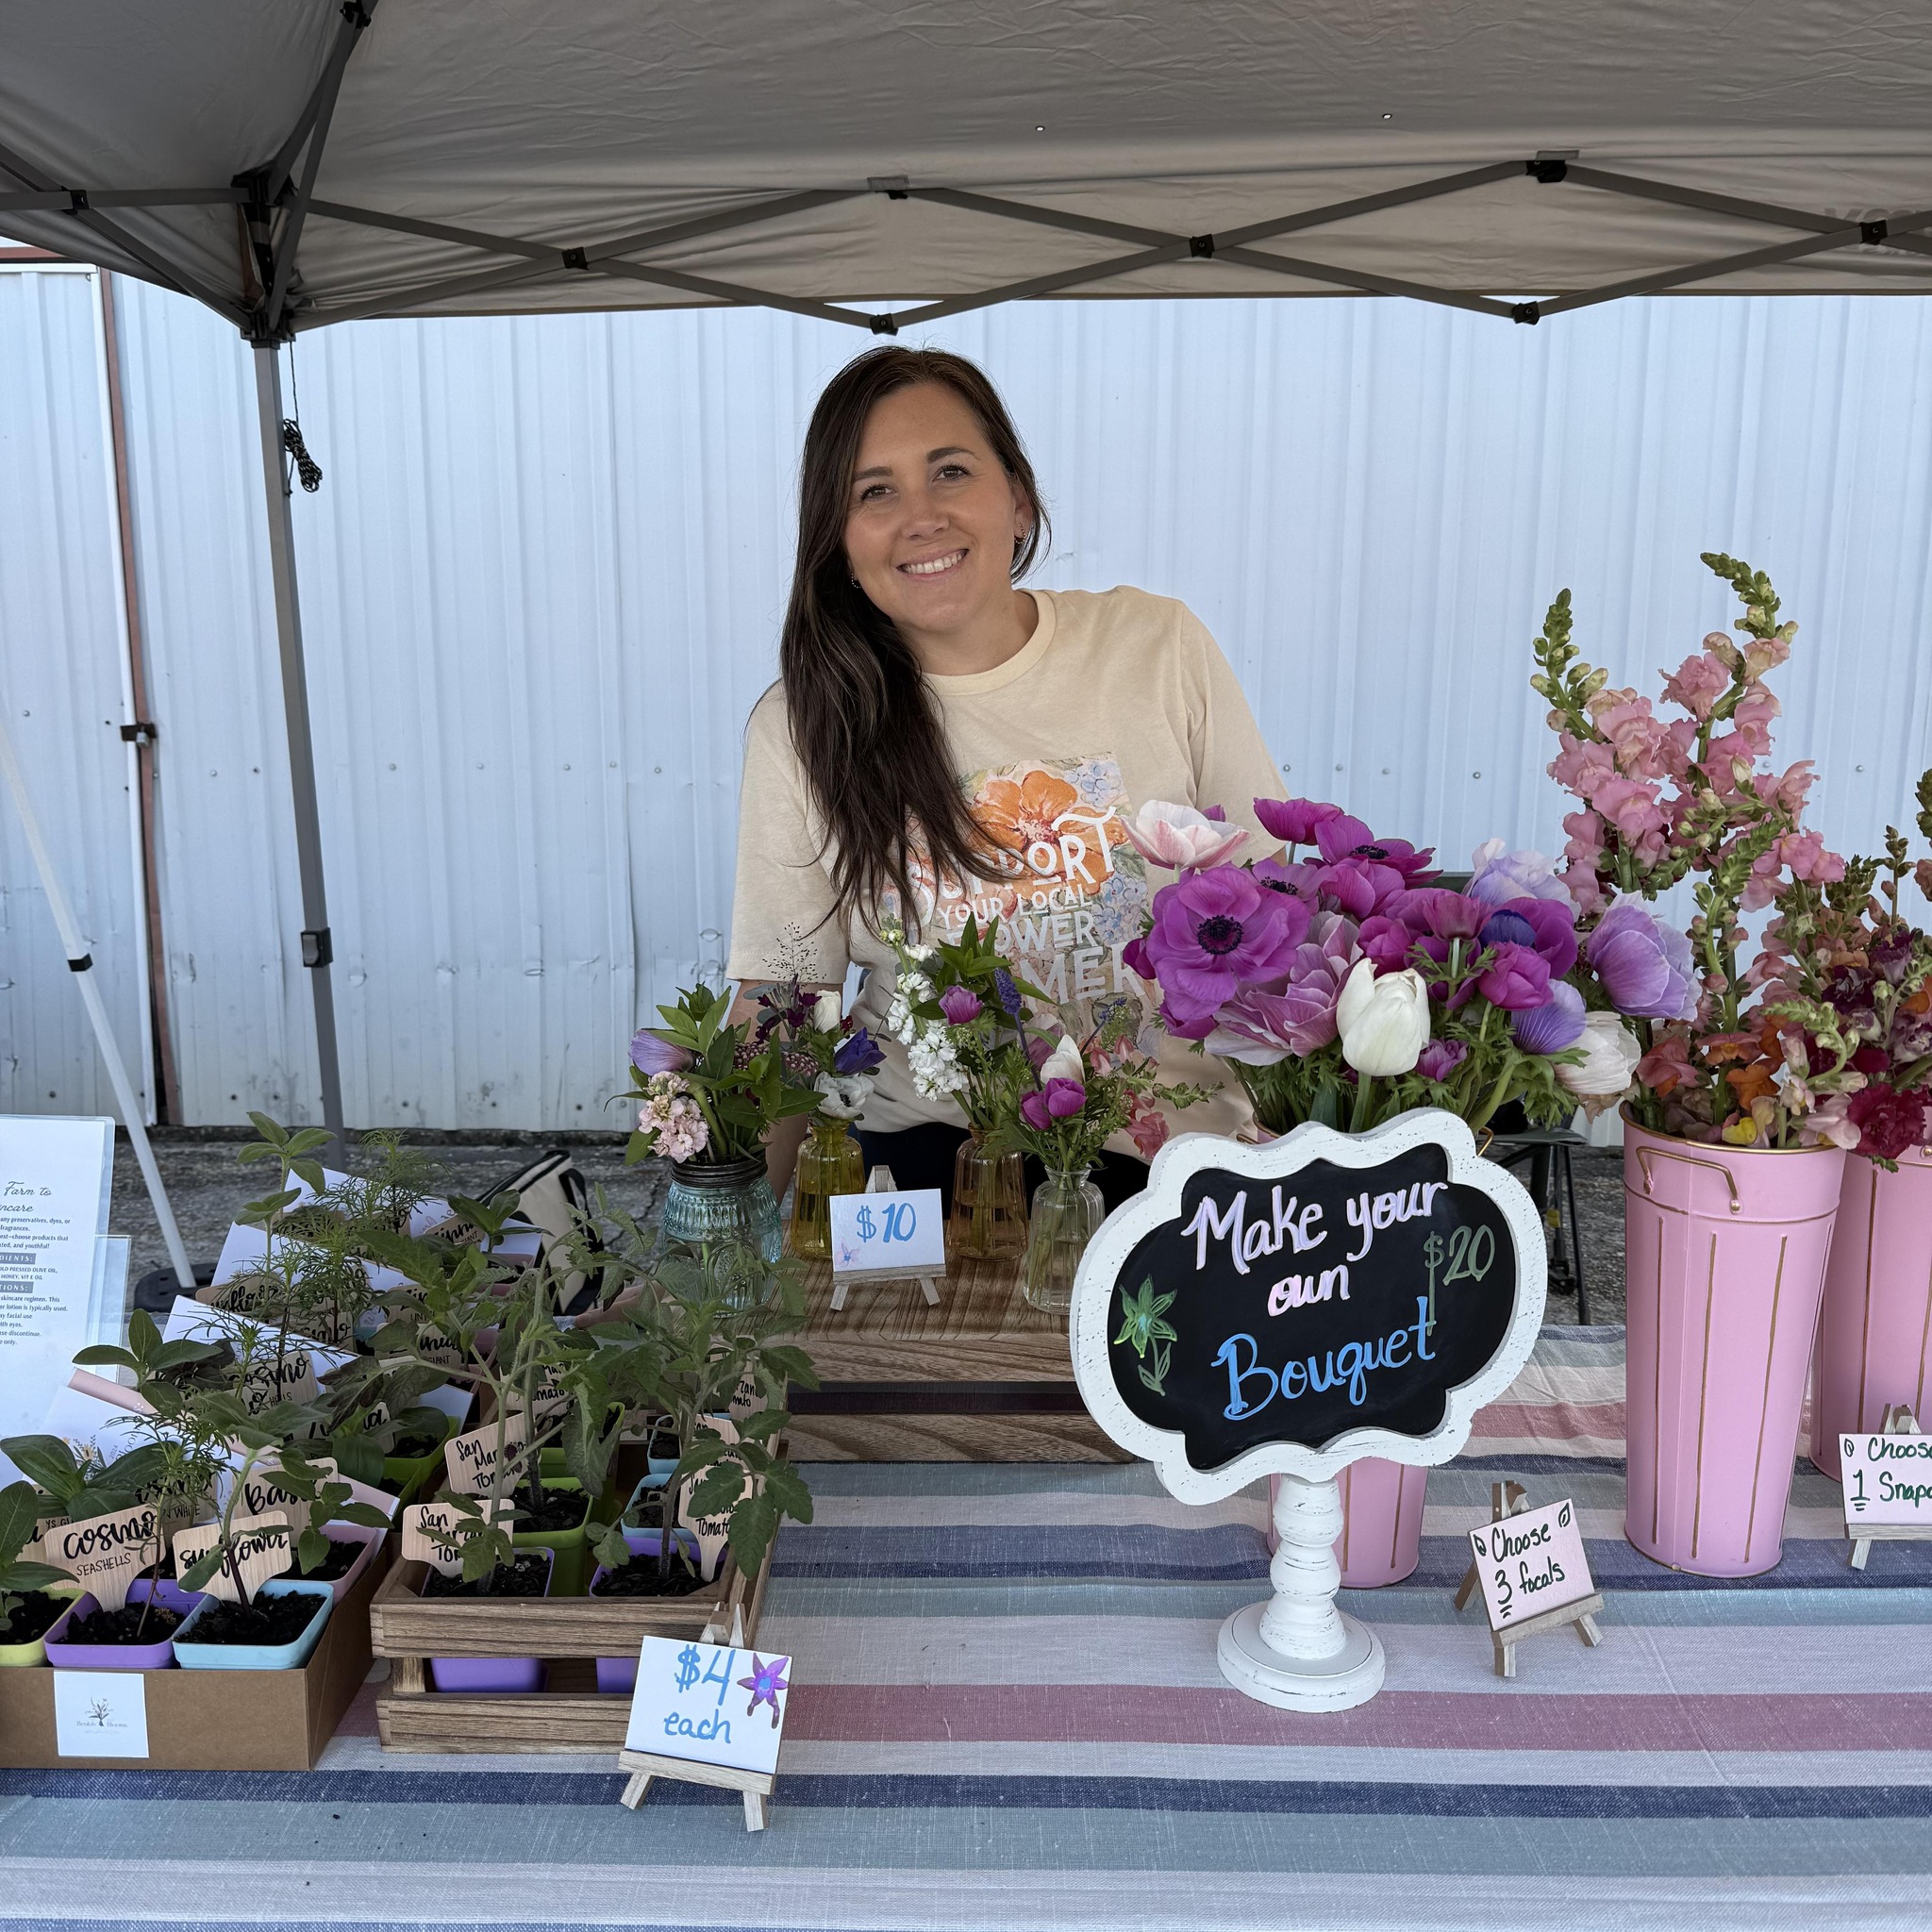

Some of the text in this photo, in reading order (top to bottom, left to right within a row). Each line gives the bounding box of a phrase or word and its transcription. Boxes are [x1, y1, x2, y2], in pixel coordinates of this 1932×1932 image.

[937, 884, 1091, 930] YOUR LOCAL
[945, 911, 1098, 953] FOWER
[0, 1204, 34, 1212] ncare
[4, 1181, 52, 1196] Farm to
[857, 1203, 916, 1242] $10
[1181, 1181, 1448, 1274] Make your
[1268, 1263, 1349, 1316] own
[1423, 1224, 1495, 1336] $20
[1211, 1296, 1436, 1421] Bouquet
[457, 1440, 481, 1461] San
[1850, 1469, 1871, 1501] 1
[421, 1506, 448, 1528] San
[1491, 1522, 1552, 1563] Choose
[76, 1553, 131, 1576] SEASHELLS
[1495, 1556, 1566, 1606] 3 focals
[675, 1644, 736, 1706] $4
[664, 1708, 731, 1744] each
